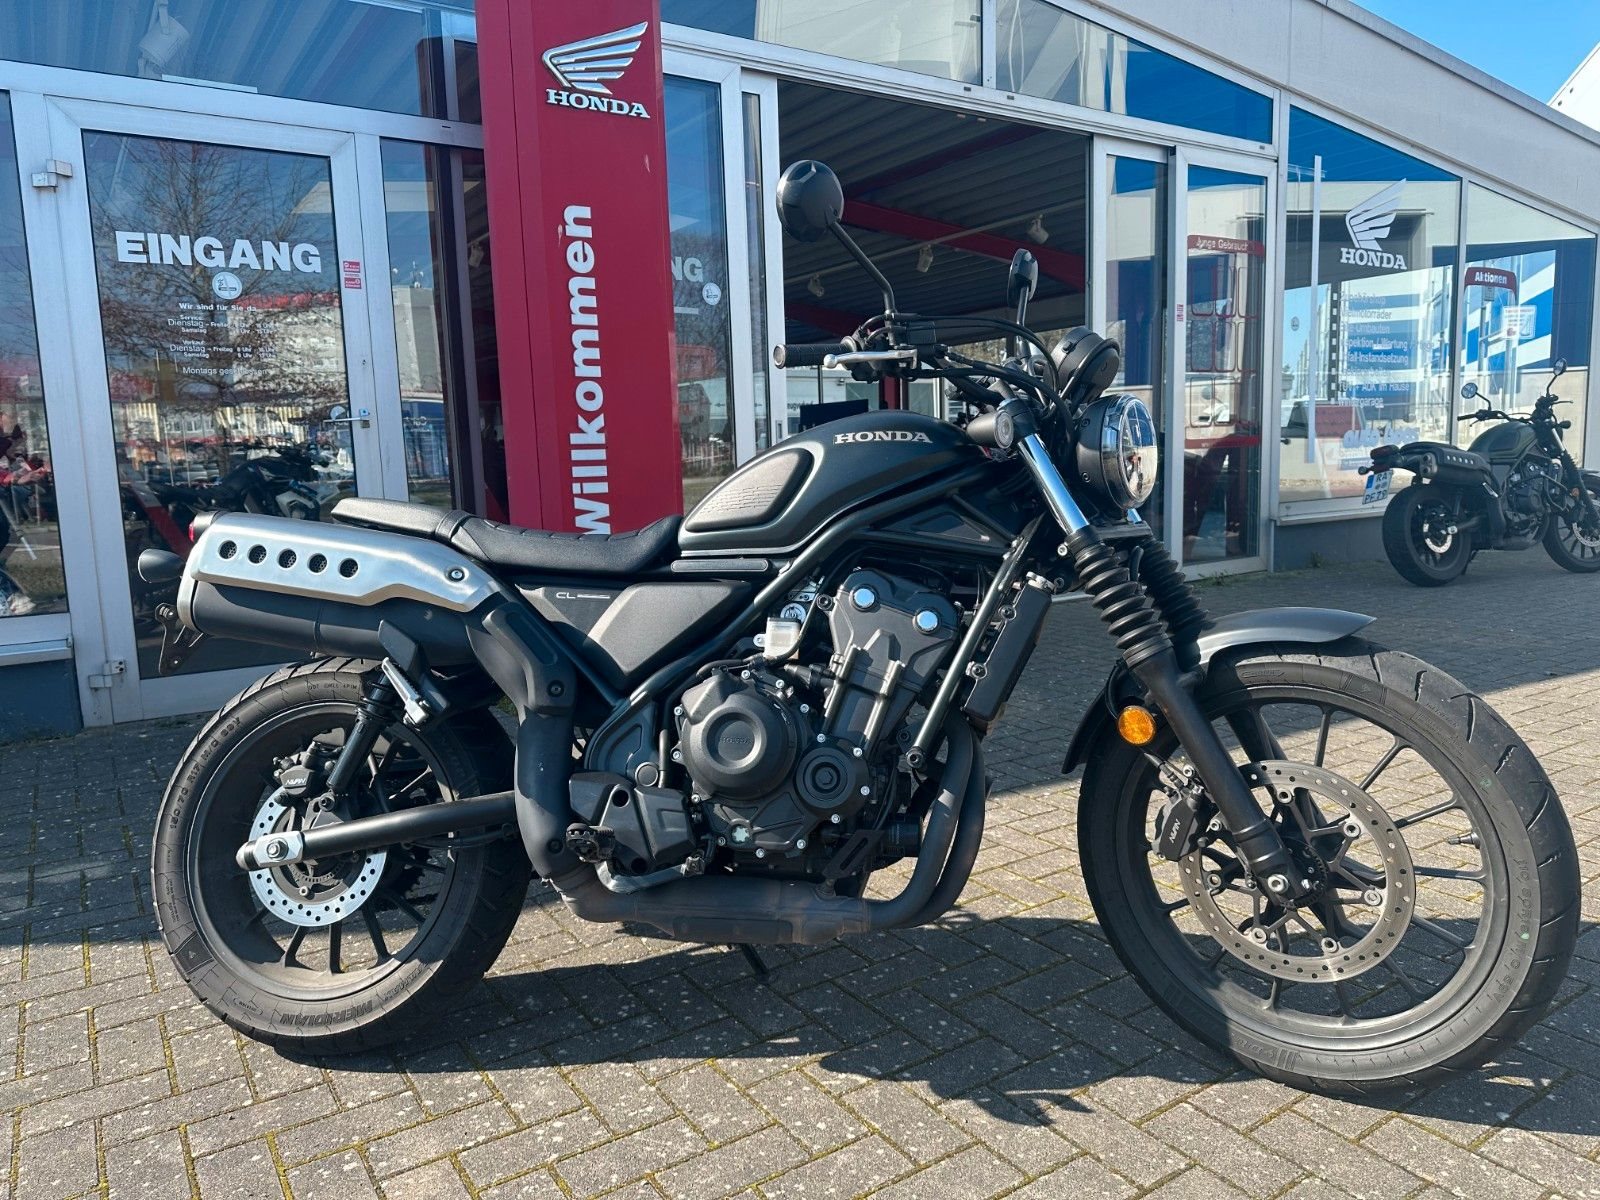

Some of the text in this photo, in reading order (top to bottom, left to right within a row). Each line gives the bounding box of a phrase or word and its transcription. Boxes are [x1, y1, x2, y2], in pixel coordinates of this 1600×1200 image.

[546, 88, 650, 118] HONDA
[115, 230, 322, 273] EINGANG
[1340, 247, 1408, 270] HONDA
[1474, 272, 1508, 284] Aktionen
[179, 302, 194, 310] Wir
[168, 319, 204, 329] Dienstag
[170, 344, 206, 354] Dienstag
[182, 367, 217, 375] Montags
[563, 205, 611, 534] Willkommen
[834, 430, 933, 445] HONDA
